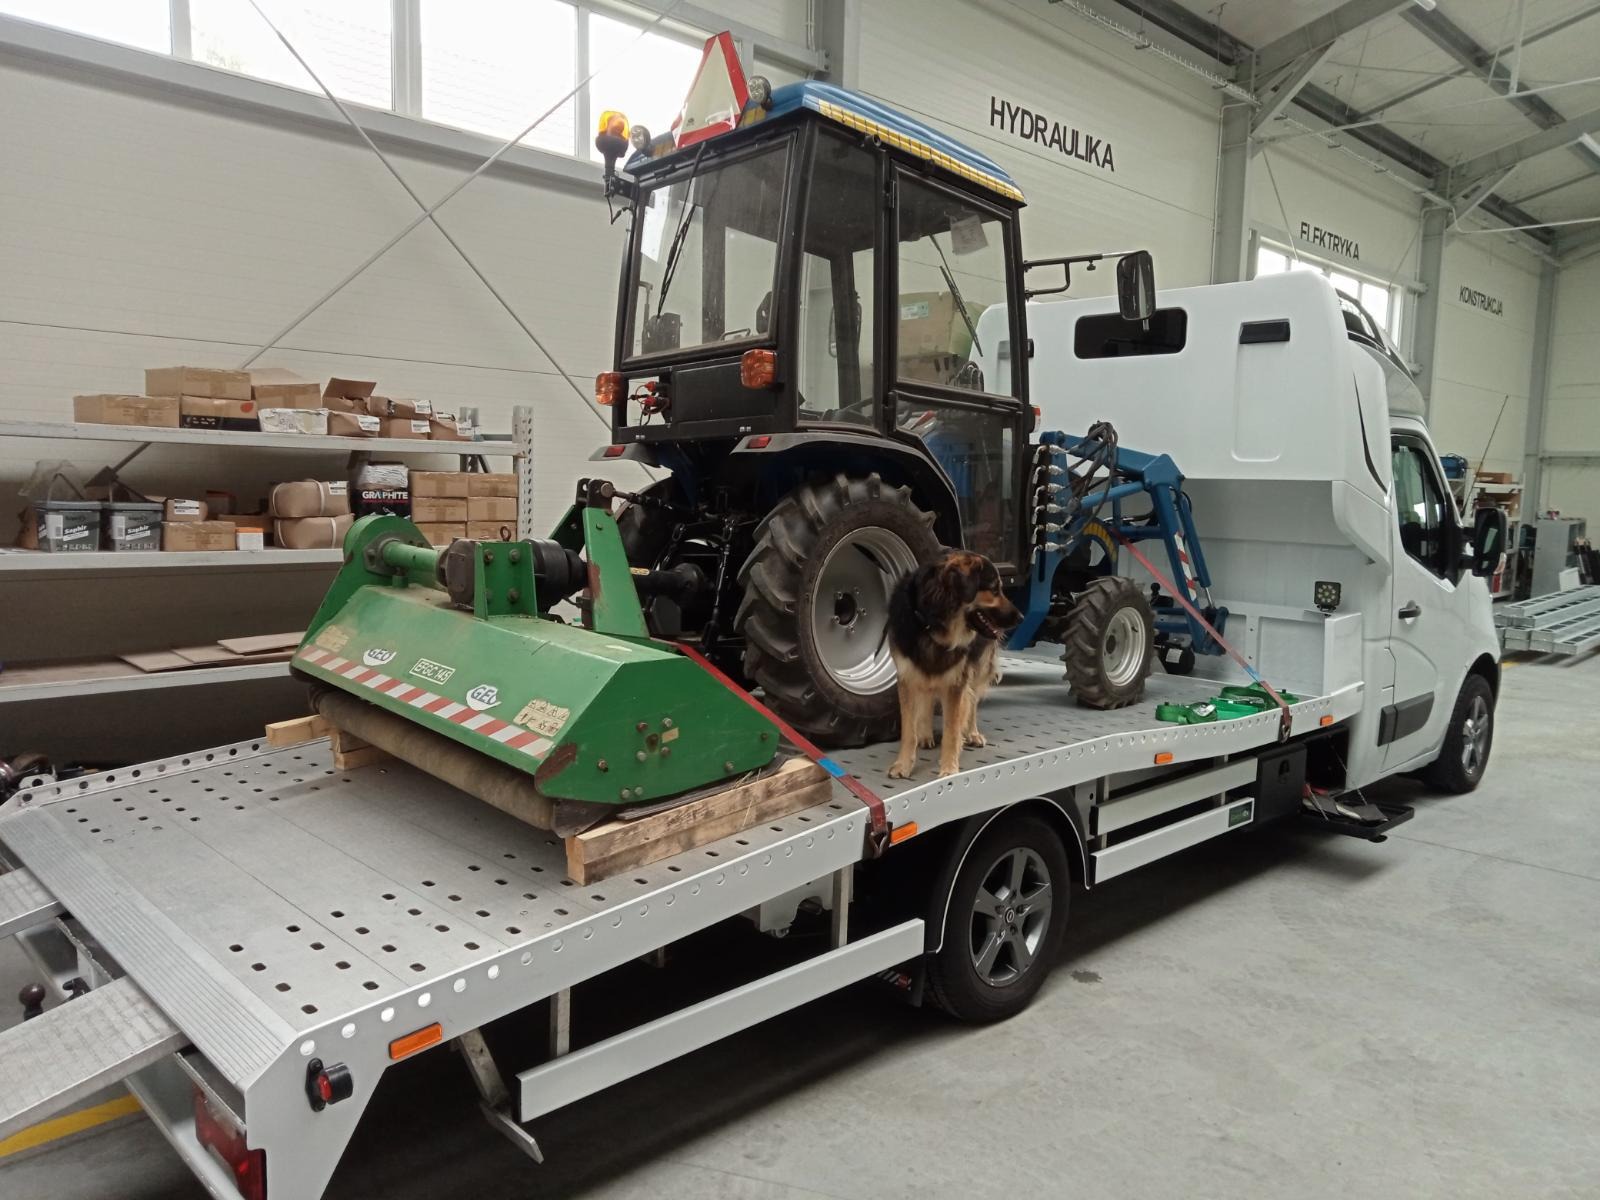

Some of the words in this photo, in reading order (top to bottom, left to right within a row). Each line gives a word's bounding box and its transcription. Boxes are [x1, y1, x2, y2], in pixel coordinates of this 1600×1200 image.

[990, 96, 1115, 172] HYDRAULIKA
[1459, 285, 1503, 317] KONSTRUKCJA
[362, 491, 408, 500] GRAPHITE
